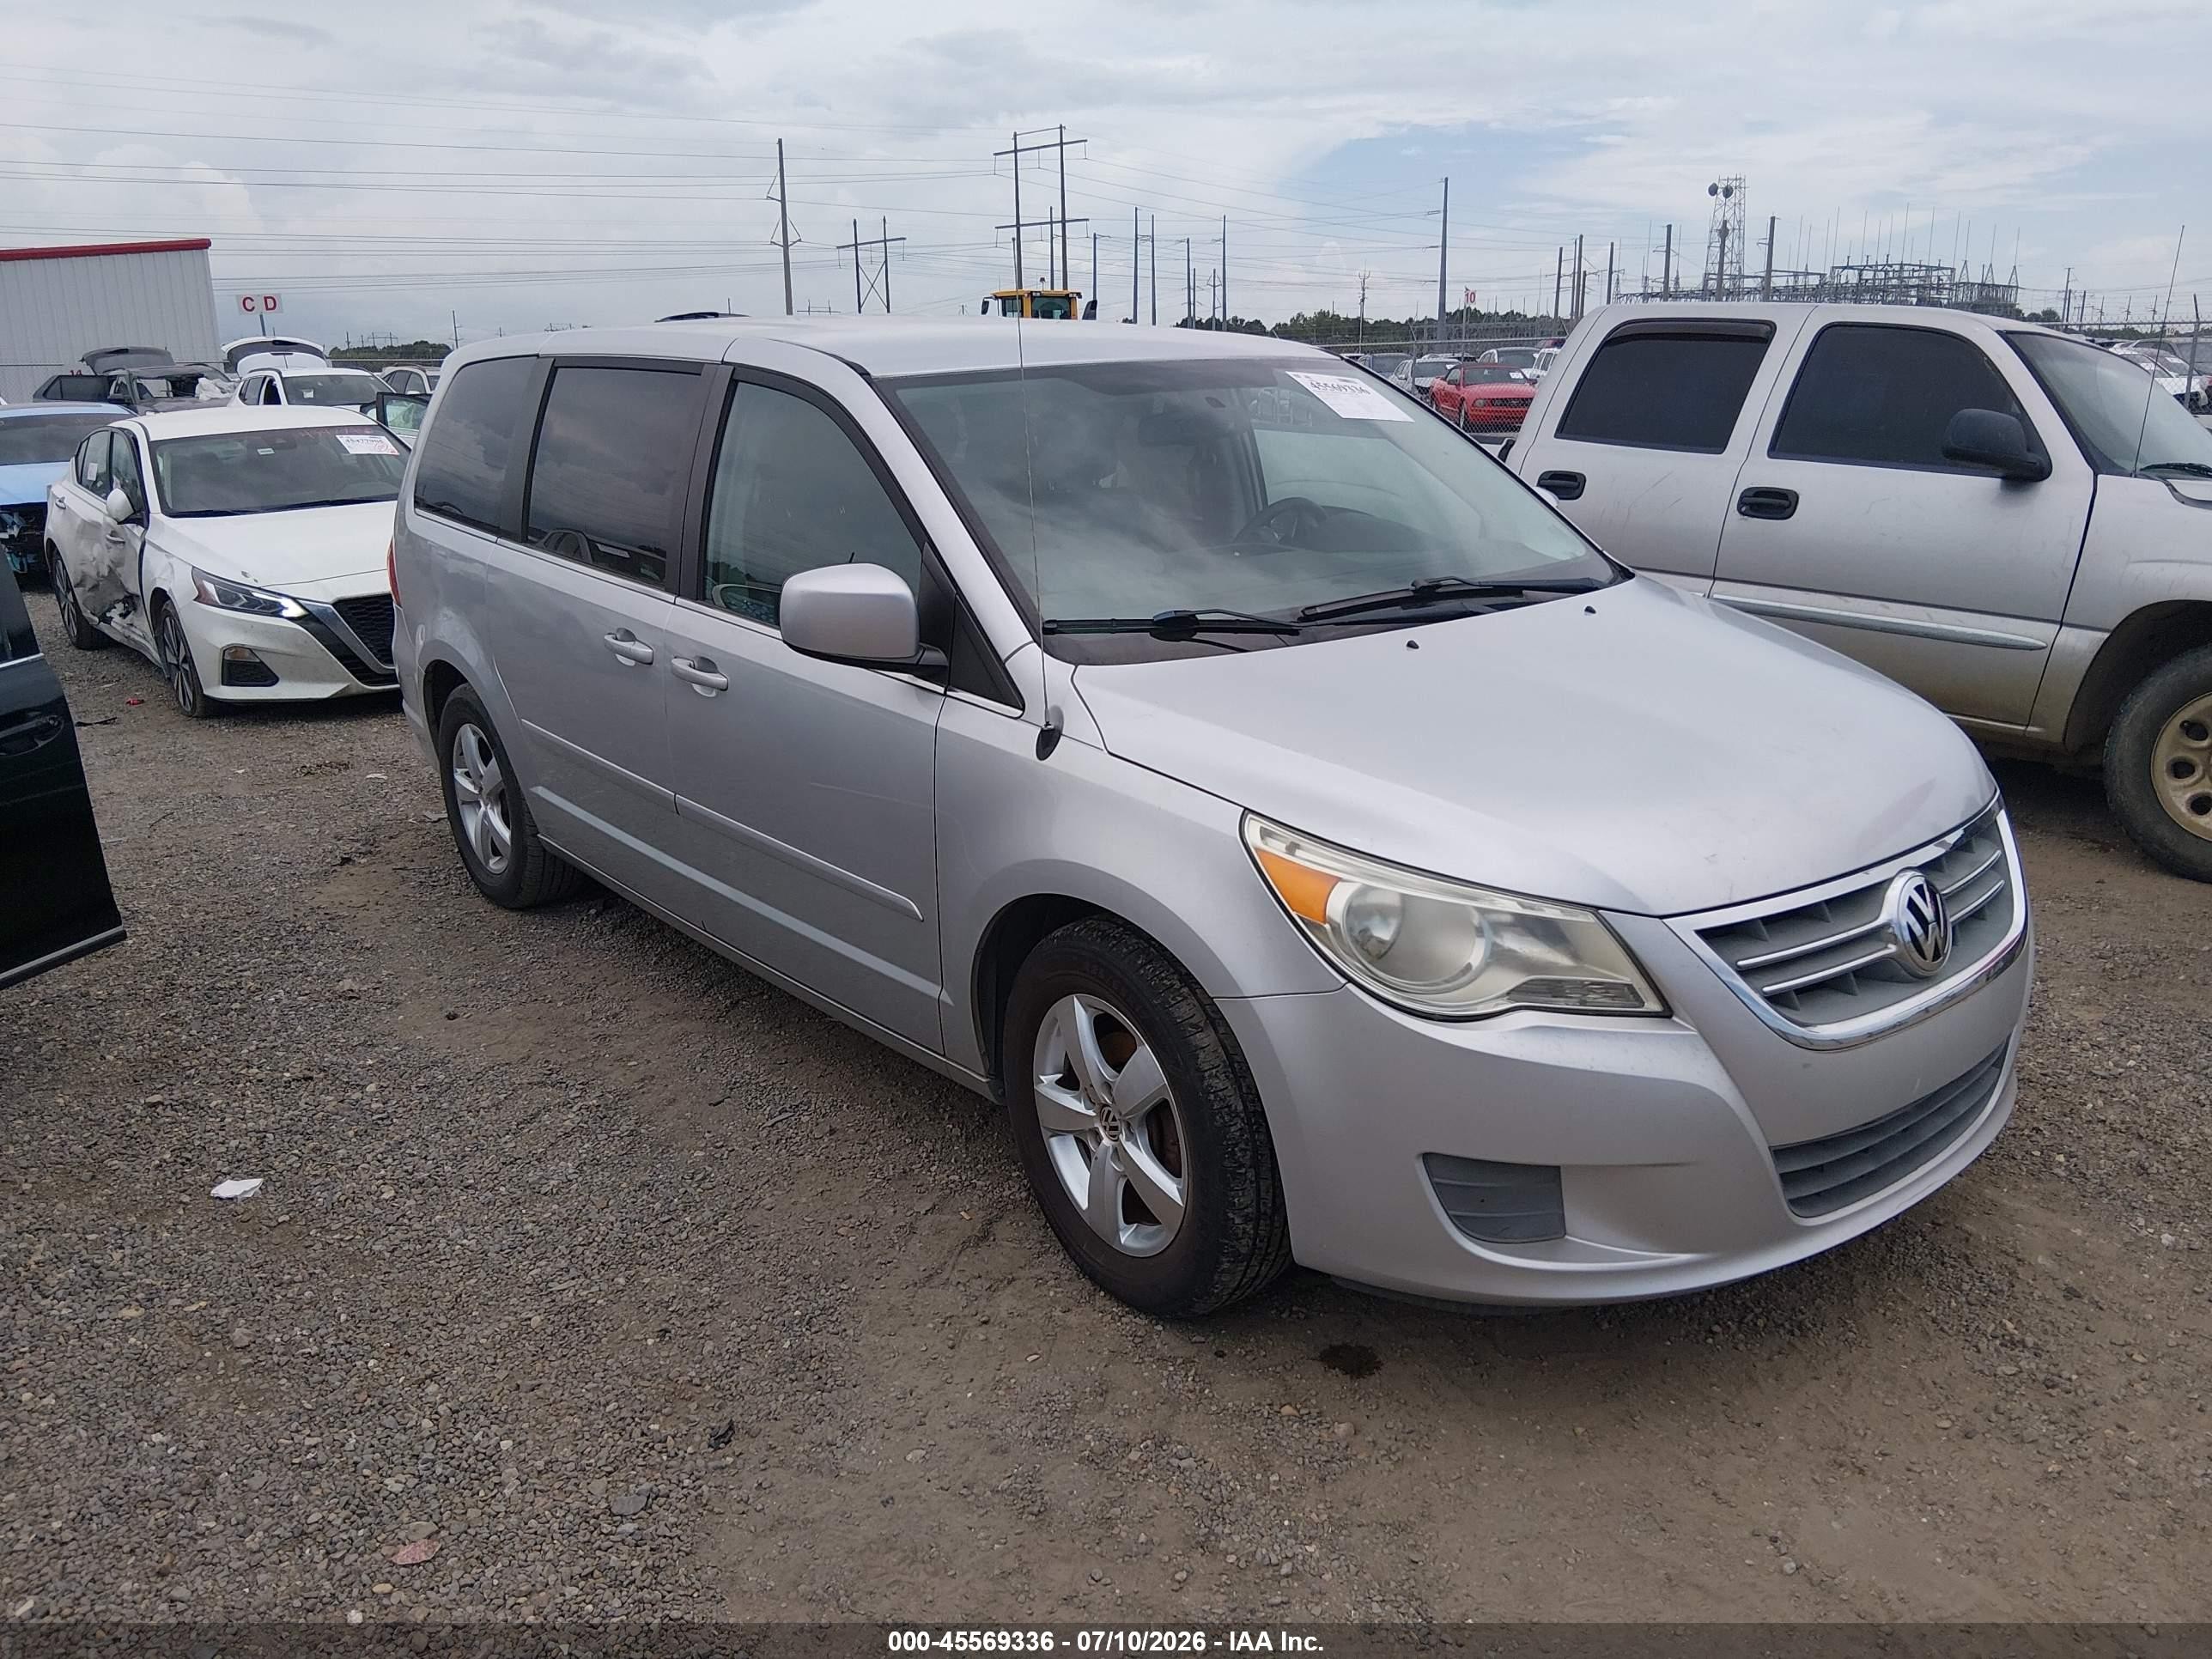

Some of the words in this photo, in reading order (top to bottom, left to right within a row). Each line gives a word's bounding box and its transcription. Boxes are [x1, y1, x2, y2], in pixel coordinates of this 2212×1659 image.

[242, 296, 255, 312] C
[264, 295, 276, 311] D
[1464, 292, 1476, 303] 10
